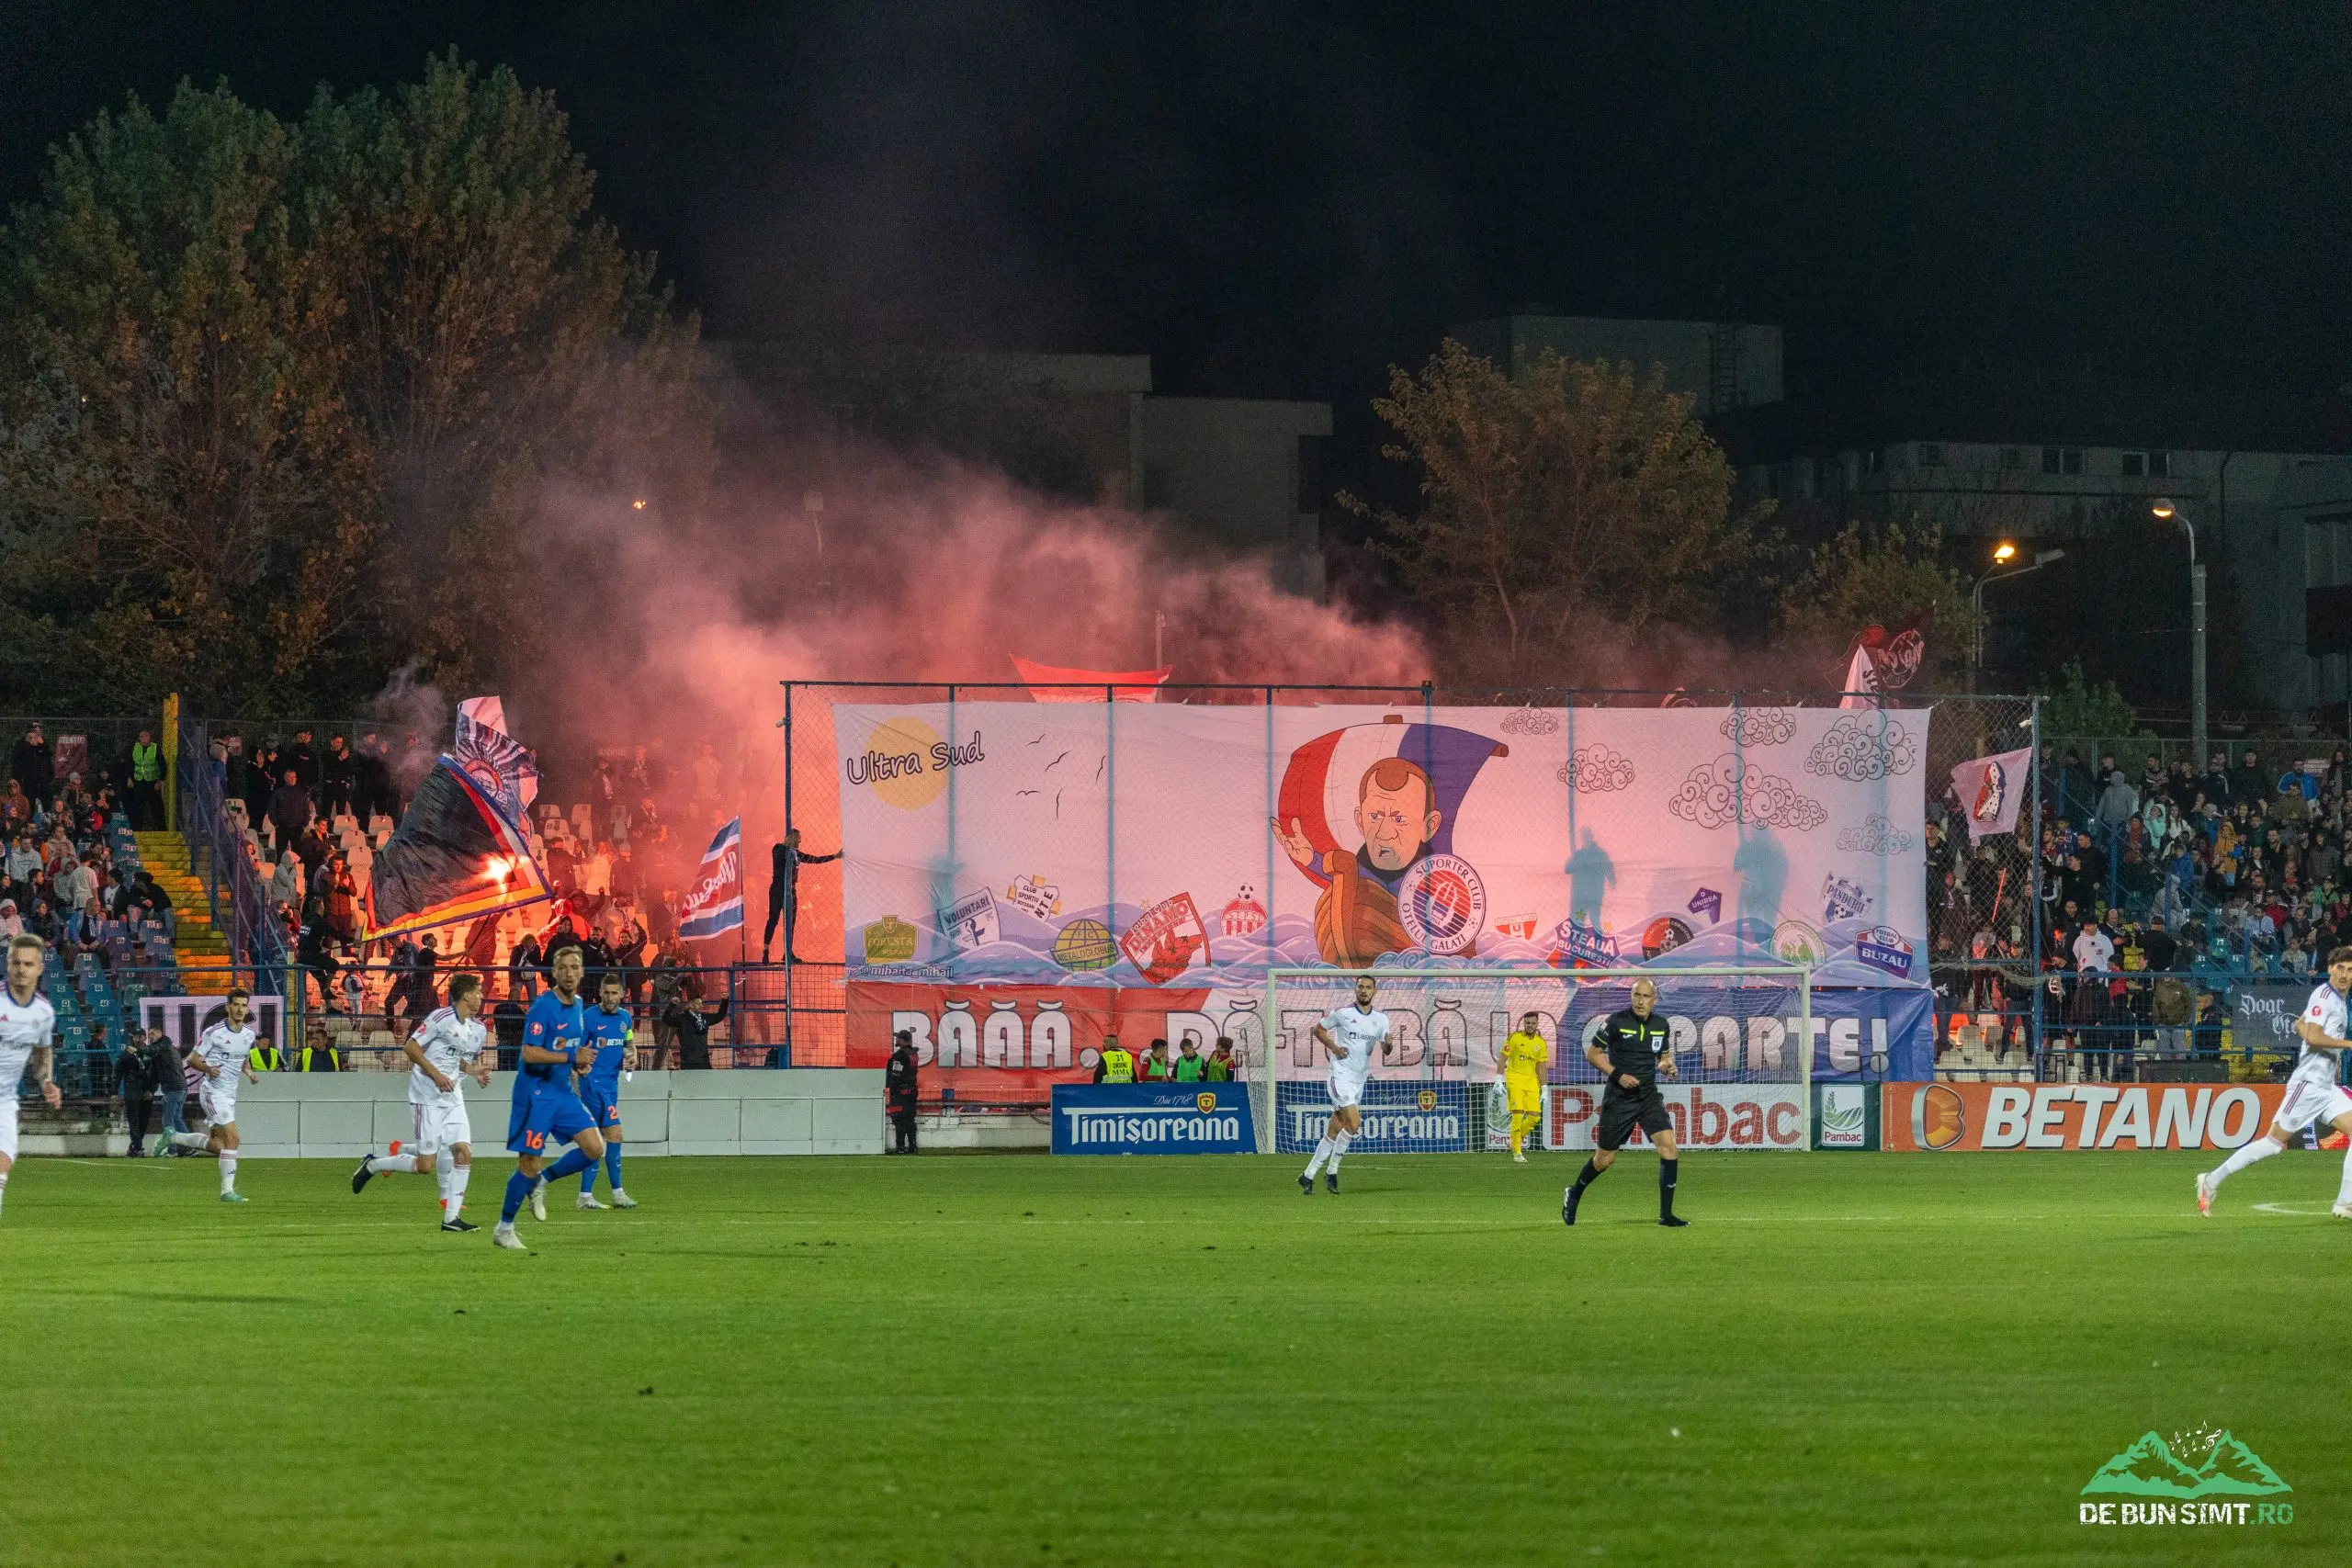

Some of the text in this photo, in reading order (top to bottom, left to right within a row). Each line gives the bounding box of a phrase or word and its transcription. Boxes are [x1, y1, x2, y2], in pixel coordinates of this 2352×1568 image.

[846, 730, 985, 785] Ultra Sud
[1023, 885, 1037, 894] CLUB
[1415, 858, 1481, 910] SUPORTER CLUB
[944, 896, 991, 924] VOLUNTARI
[1017, 892, 1040, 903] SPORTIV
[1691, 894, 1718, 908] UNIREA
[1826, 884, 1865, 914] PANDURII
[1129, 902, 1189, 953] DINAMO
[1402, 902, 1466, 951] OTELUL GALATI
[1559, 920, 1615, 956] STEAUA
[1875, 929, 1899, 940] FOTBAL
[1879, 935, 1895, 944] CLUB
[867, 936, 914, 947] FORESTA
[1057, 943, 1114, 961] METALOGLOBUS
[1557, 939, 1611, 965] BUCURESTI
[1861, 947, 1908, 968] BUZAU
[1381, 998, 1469, 1067] BĂ
[1062, 1107, 1239, 1145] Timișoreana
[1981, 1085, 2262, 1150] BETANO
[526, 1129, 543, 1150] 16
[1824, 1131, 1862, 1143] Pambac
